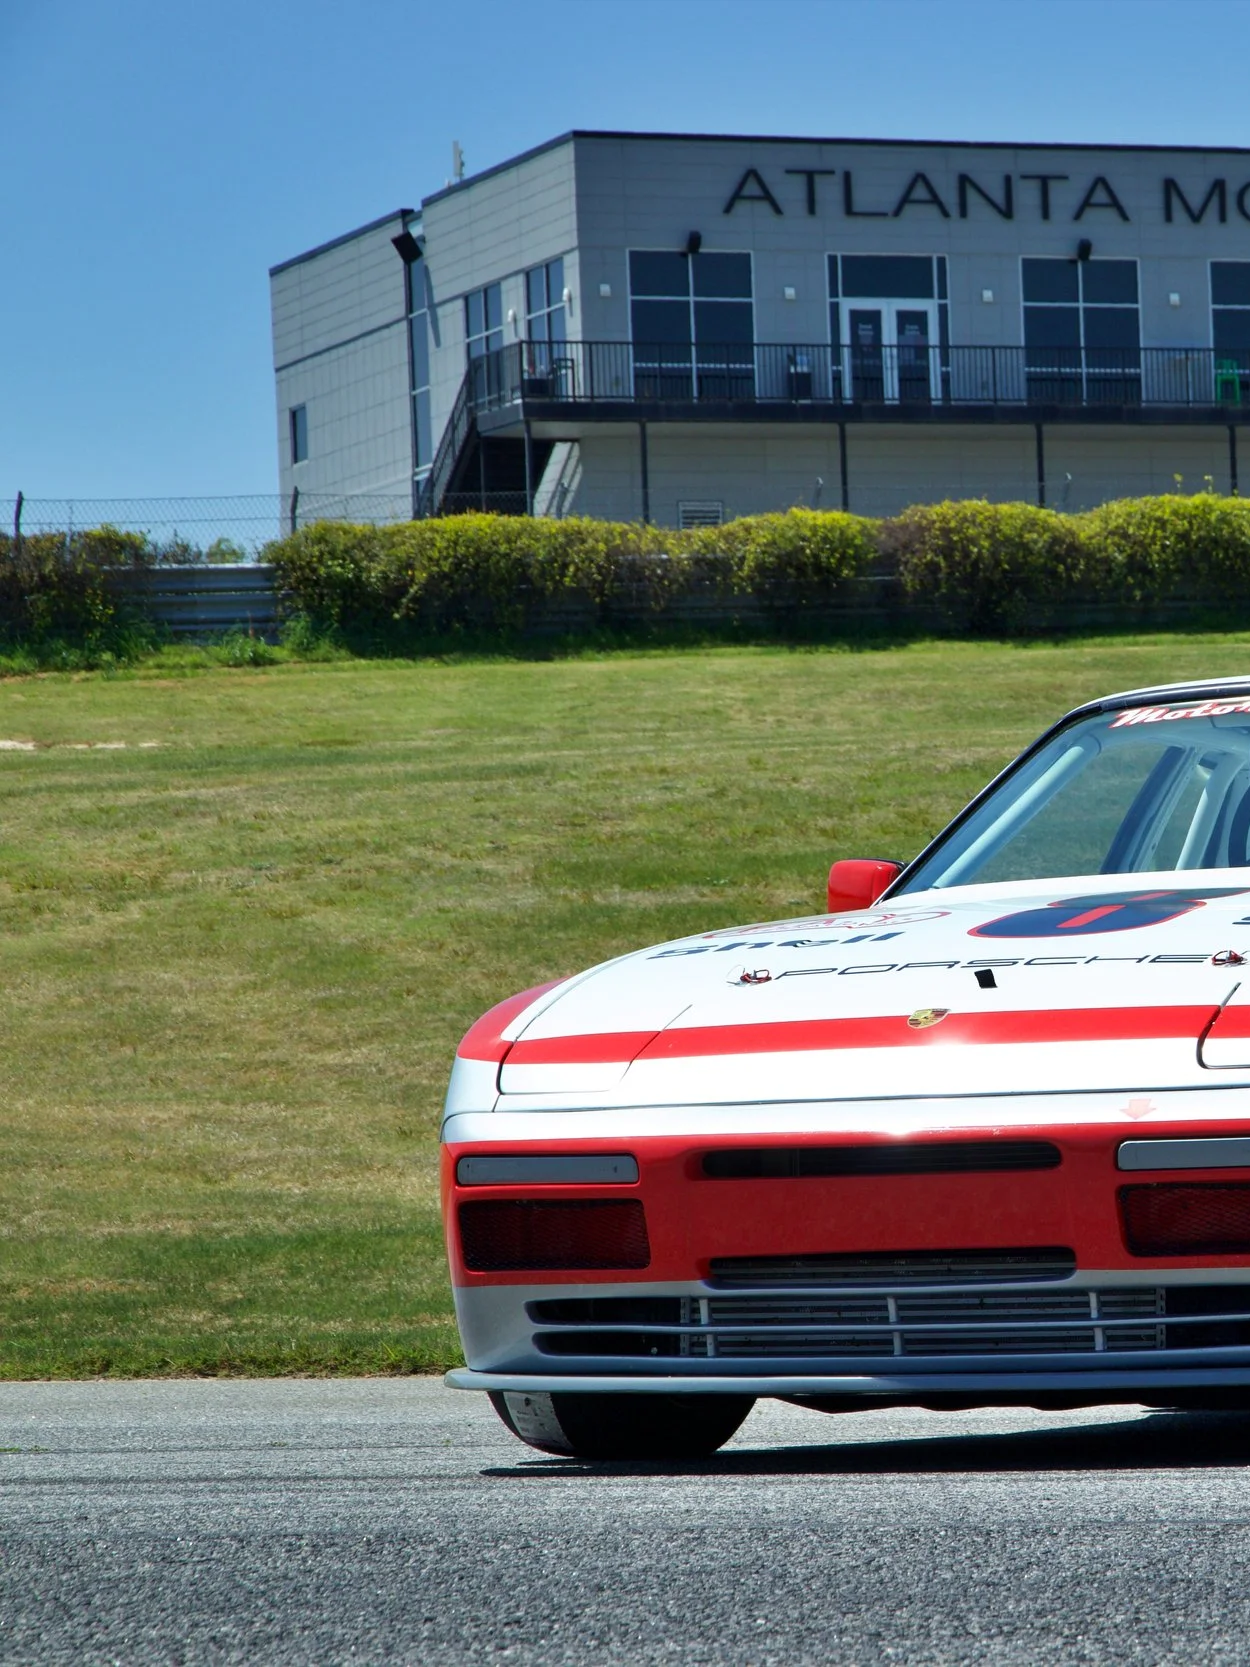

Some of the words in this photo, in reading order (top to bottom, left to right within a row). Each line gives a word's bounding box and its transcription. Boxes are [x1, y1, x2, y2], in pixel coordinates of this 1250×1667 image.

[722, 167, 1132, 224] ATLANTA
[646, 931, 906, 960] Shell
[774, 953, 1213, 981] PORSCHE
